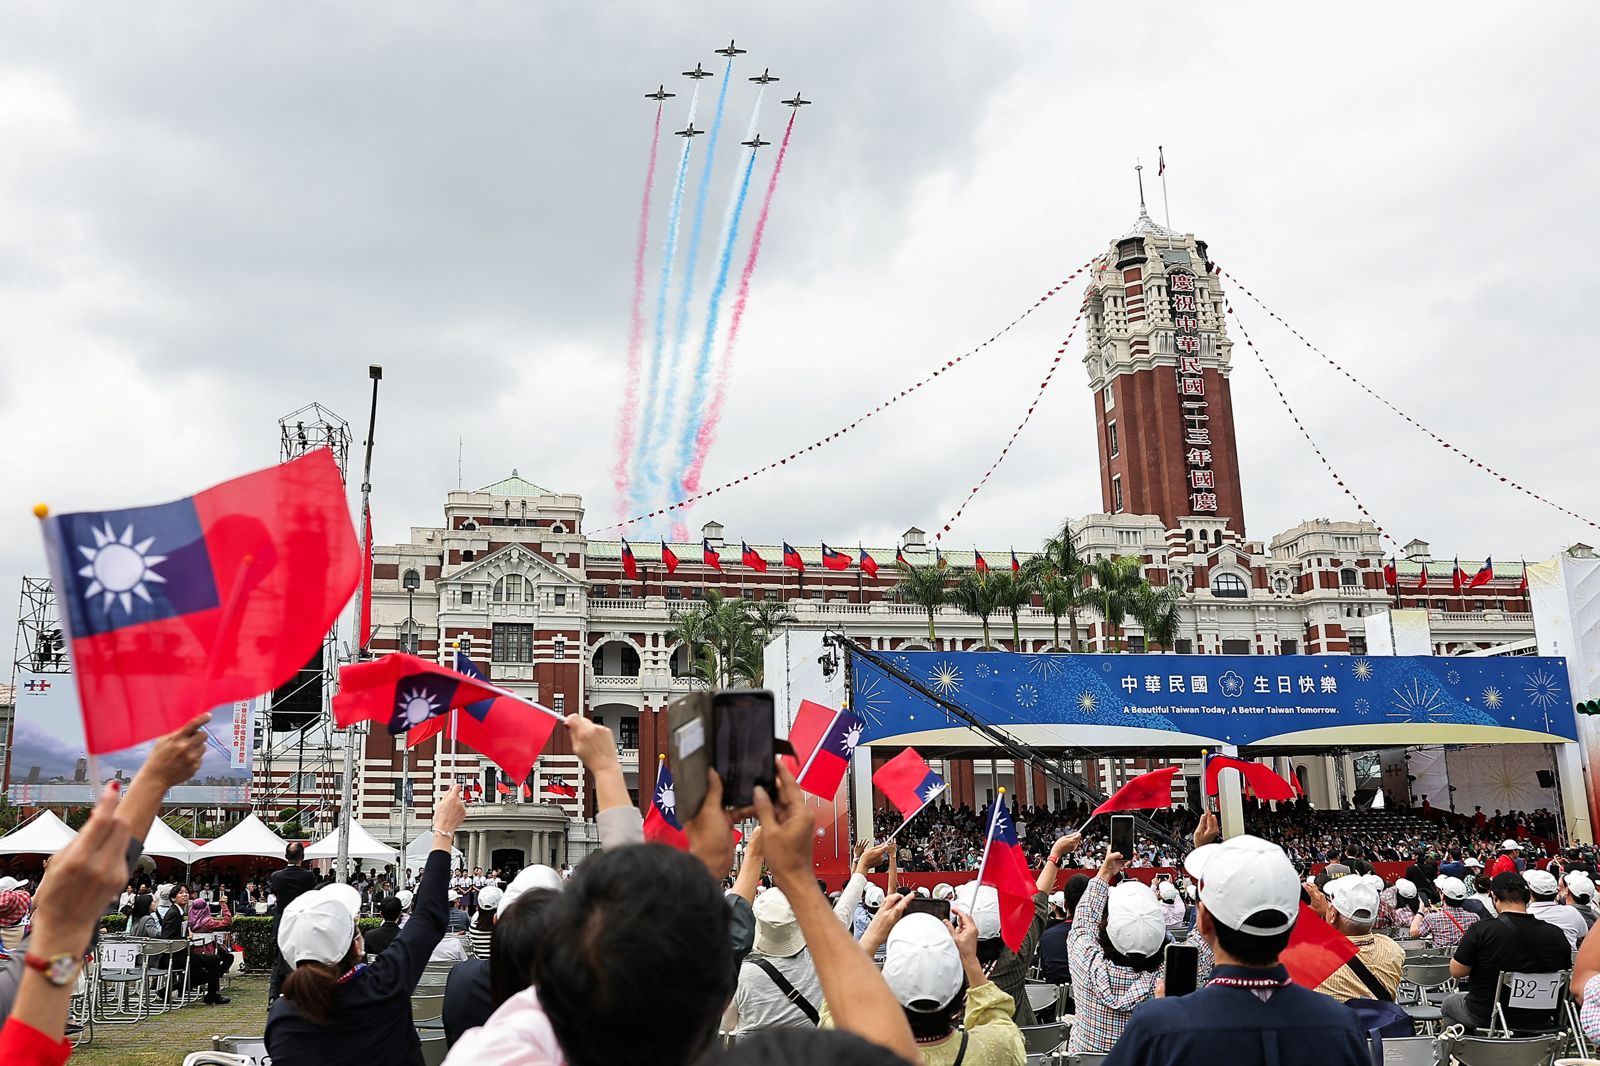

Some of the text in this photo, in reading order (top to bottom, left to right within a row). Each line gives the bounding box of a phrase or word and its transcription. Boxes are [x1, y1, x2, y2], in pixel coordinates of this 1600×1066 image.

[1121, 674, 1338, 694] 中華民國 生日快樂
[1123, 706, 1130, 714] A
[1131, 705, 1169, 714] Beautiful
[1170, 705, 1200, 714] Taiwan
[1231, 706, 1238, 714] A
[1239, 706, 1265, 714] Better
[1266, 706, 1295, 714] Taiwan
[1296, 706, 1340, 714] Tomorrow.
[103, 949, 135, 962] A1-5
[1511, 978, 1559, 999] B2-7
